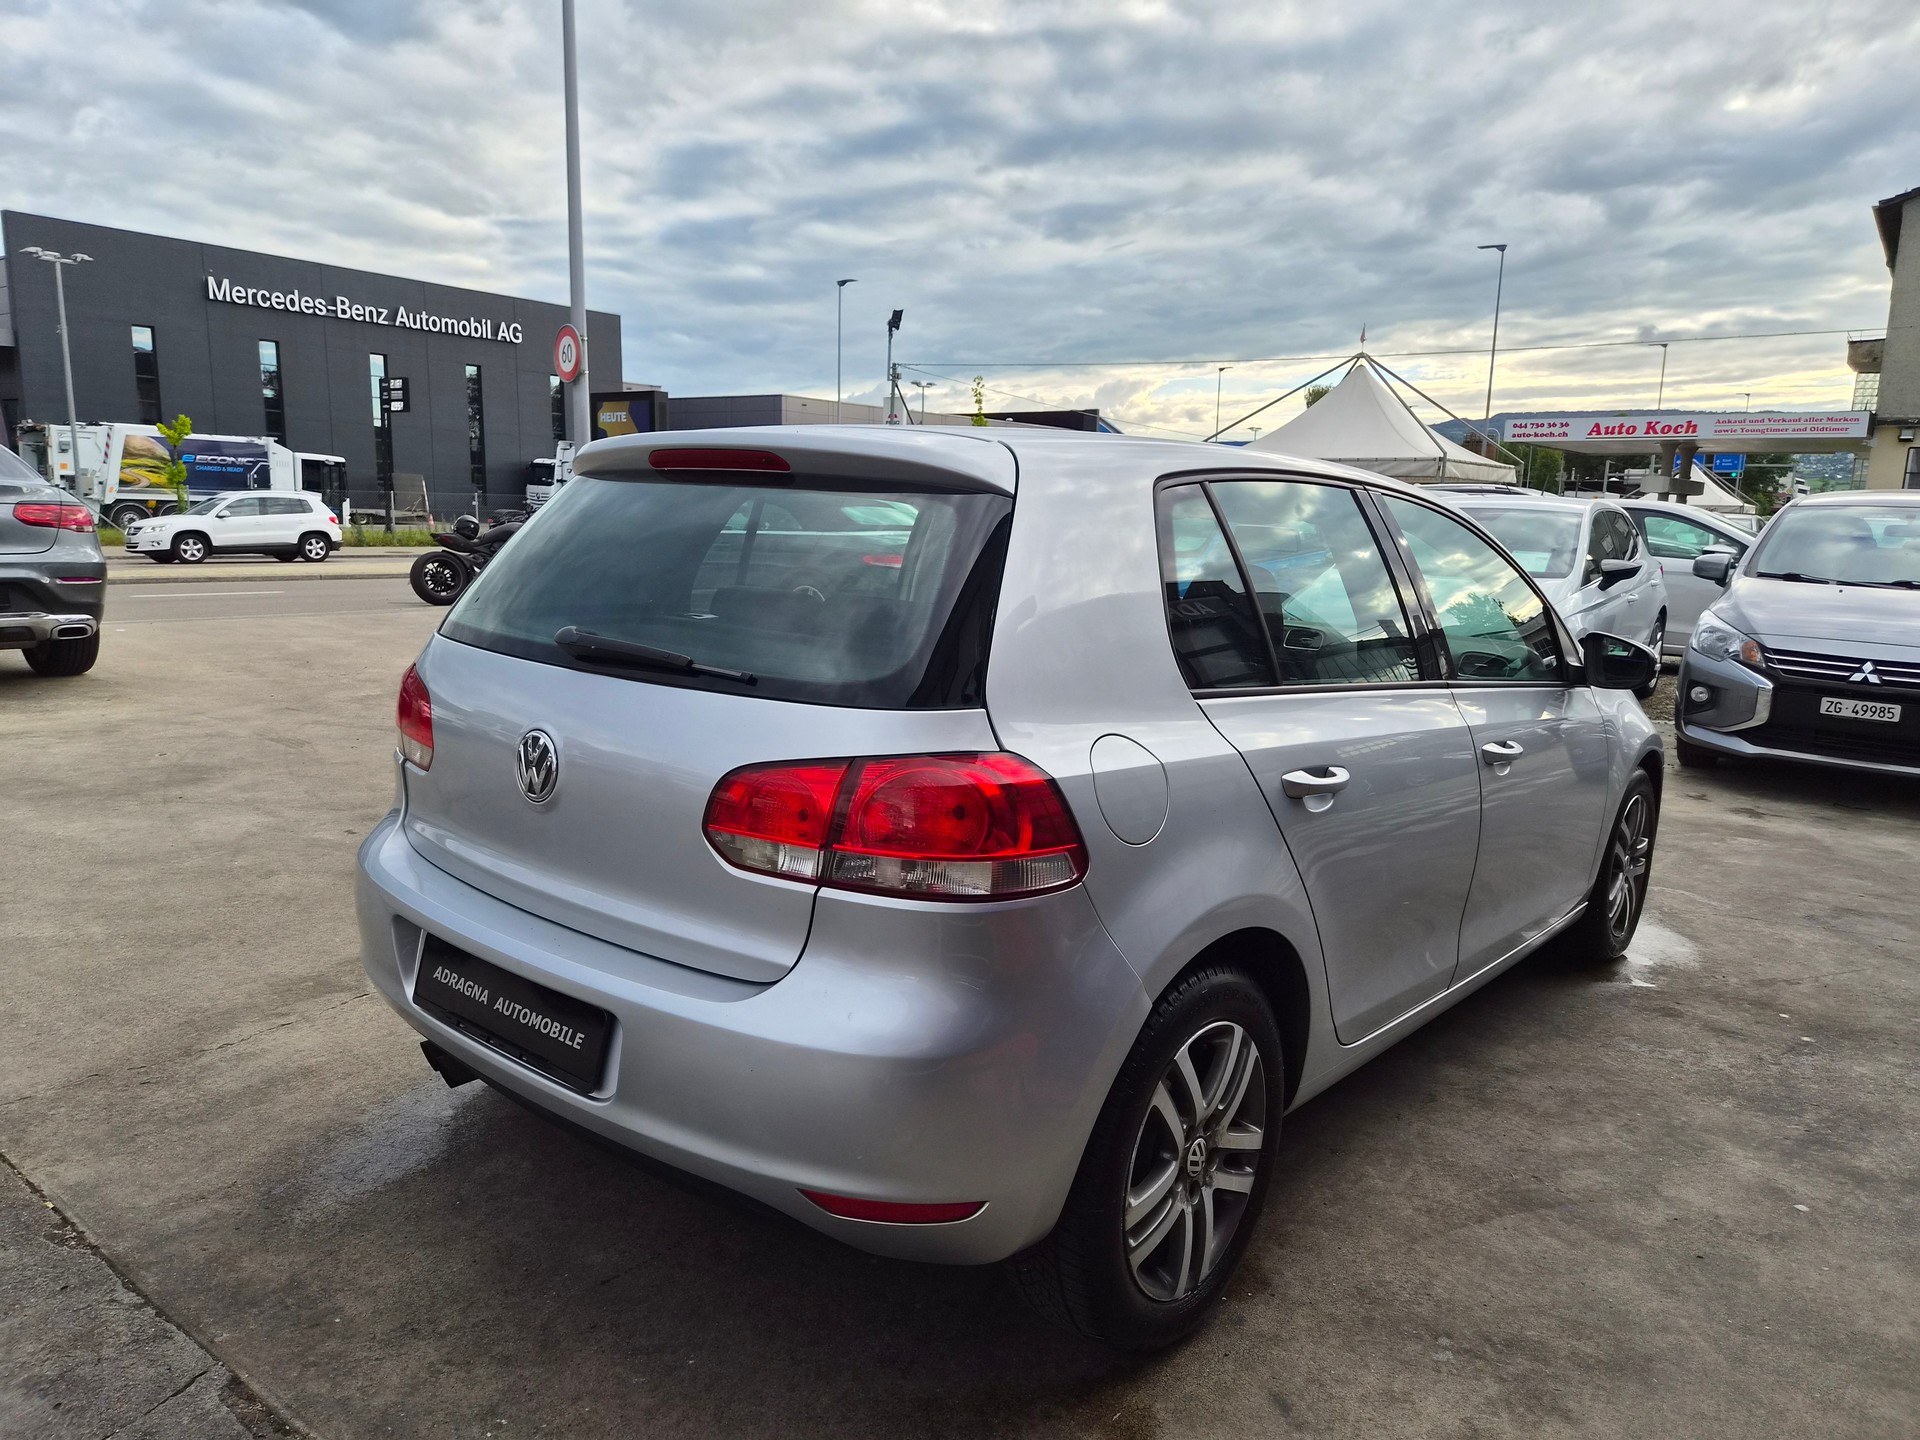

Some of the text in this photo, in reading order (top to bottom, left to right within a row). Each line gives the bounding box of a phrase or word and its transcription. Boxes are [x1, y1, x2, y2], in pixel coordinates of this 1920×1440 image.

[207, 276, 523, 344] Mercedes-Benz Automobil AG
[562, 343, 573, 363] 60
[600, 411, 627, 422] HEUTE
[1587, 420, 1698, 436] Auto Koch
[1740, 426, 1789, 435] Youngtimer
[1825, 700, 1896, 720] ZG 49985
[433, 966, 586, 1050] ADRAGNA AUTOMOBILE
